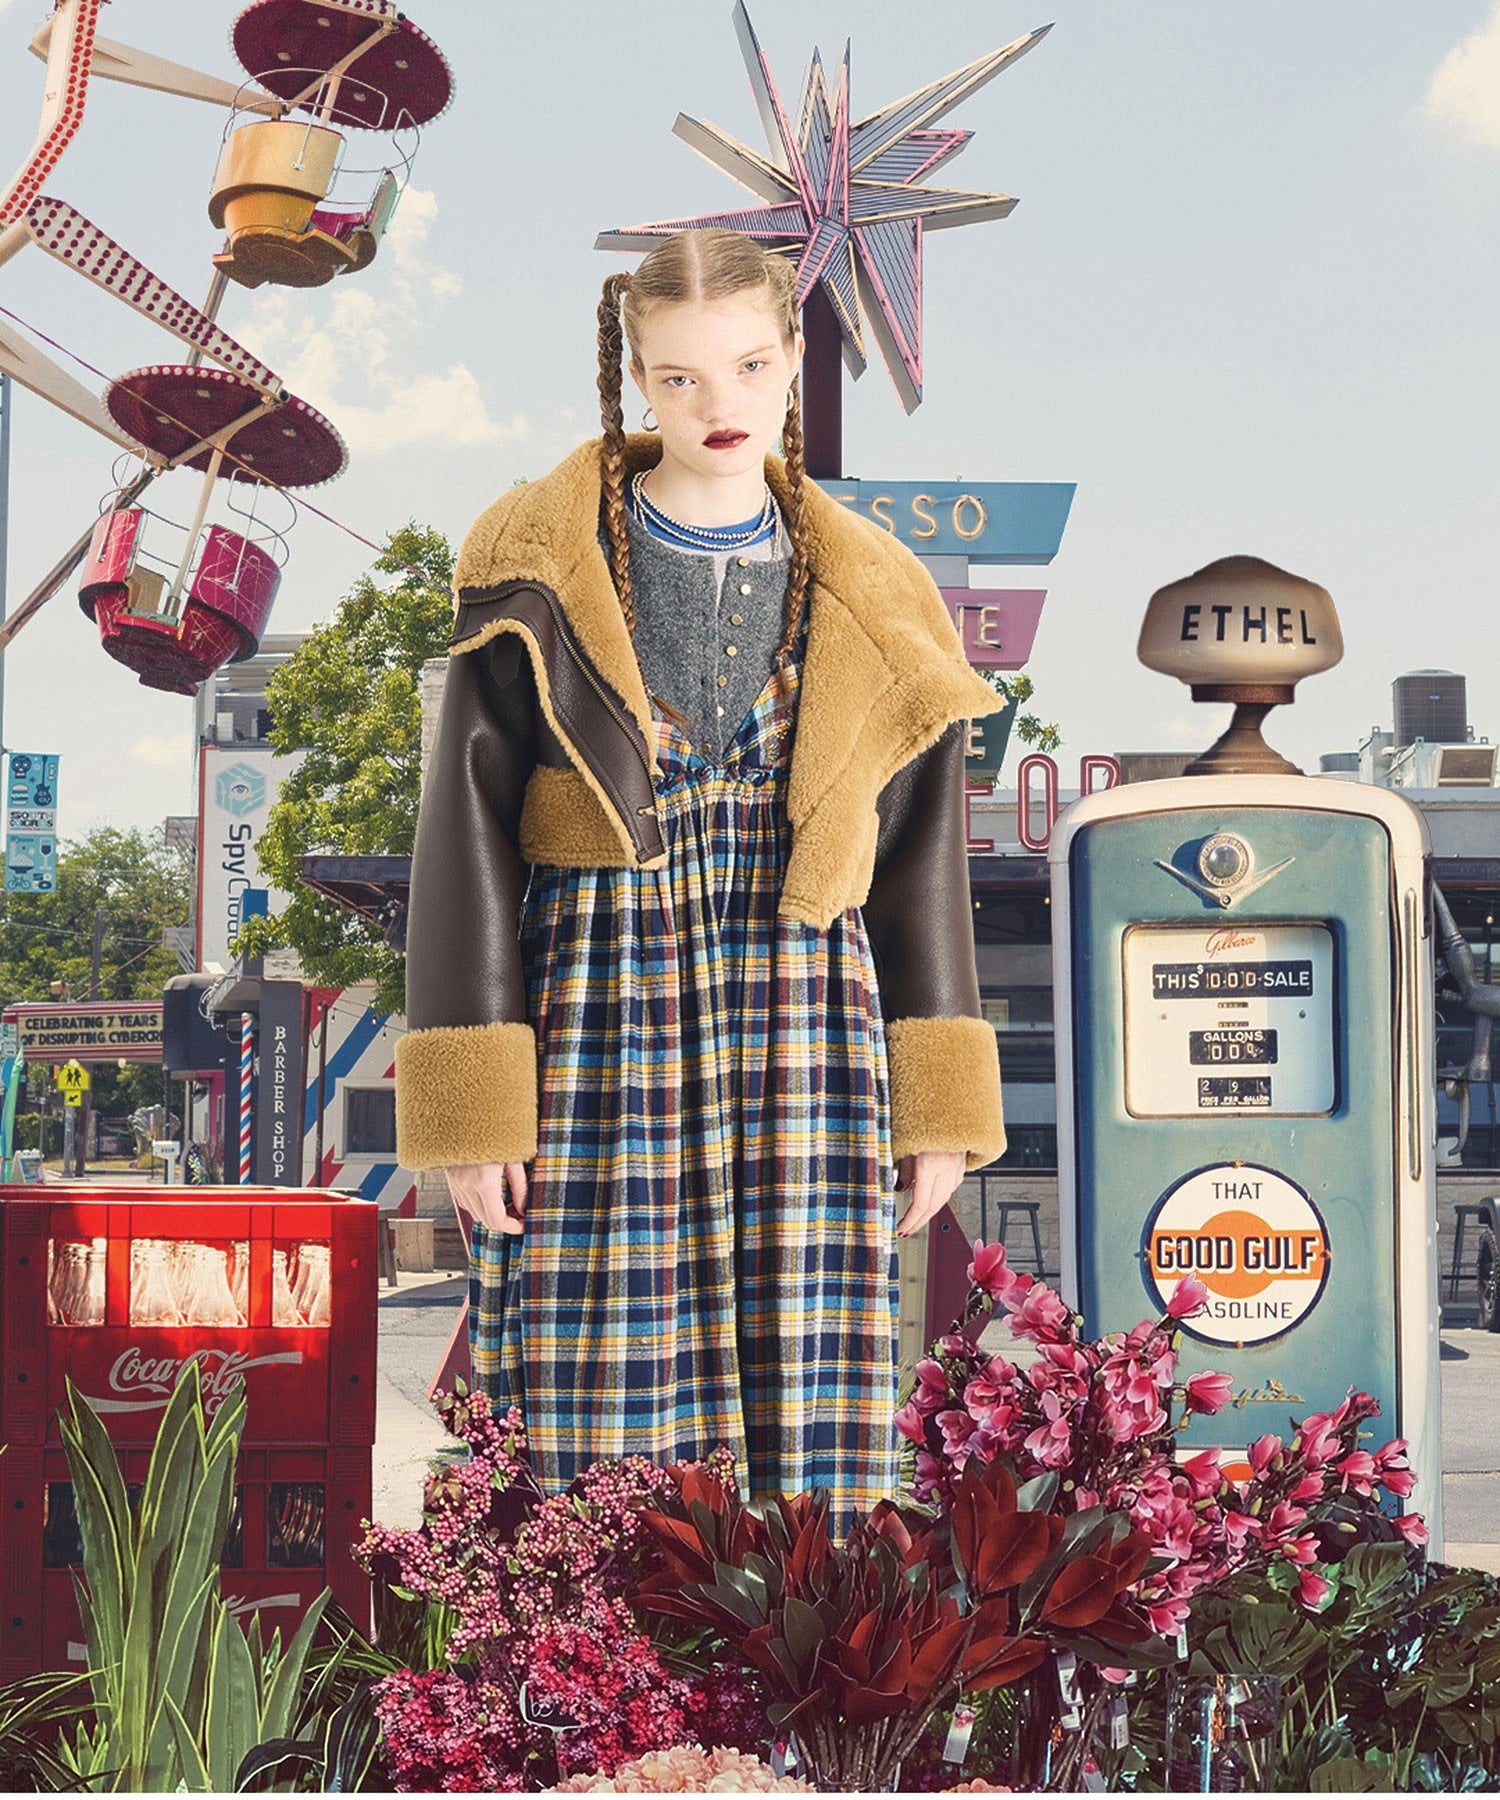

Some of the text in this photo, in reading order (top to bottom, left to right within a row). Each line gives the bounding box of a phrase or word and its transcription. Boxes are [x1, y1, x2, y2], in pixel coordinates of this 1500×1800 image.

[833, 494, 988, 541] SSO
[1181, 605, 1316, 645] ETHEL
[1155, 974, 1200, 989] THIS
[1263, 971, 1310, 986] SALE
[25, 1014, 158, 1030] CELEBRATING 7 YEARS
[38, 1031, 105, 1046] DISRUPTING
[1203, 1031, 1264, 1043] GALLONS
[273, 1026, 287, 1114] BARBER
[272, 1121, 286, 1179] SHOP
[1211, 1182, 1264, 1200] THAT
[1156, 1235, 1320, 1274] GOOD GULF
[1200, 1302, 1293, 1318] ASOLINE
[109, 1346, 250, 1396] Coca-Cola
